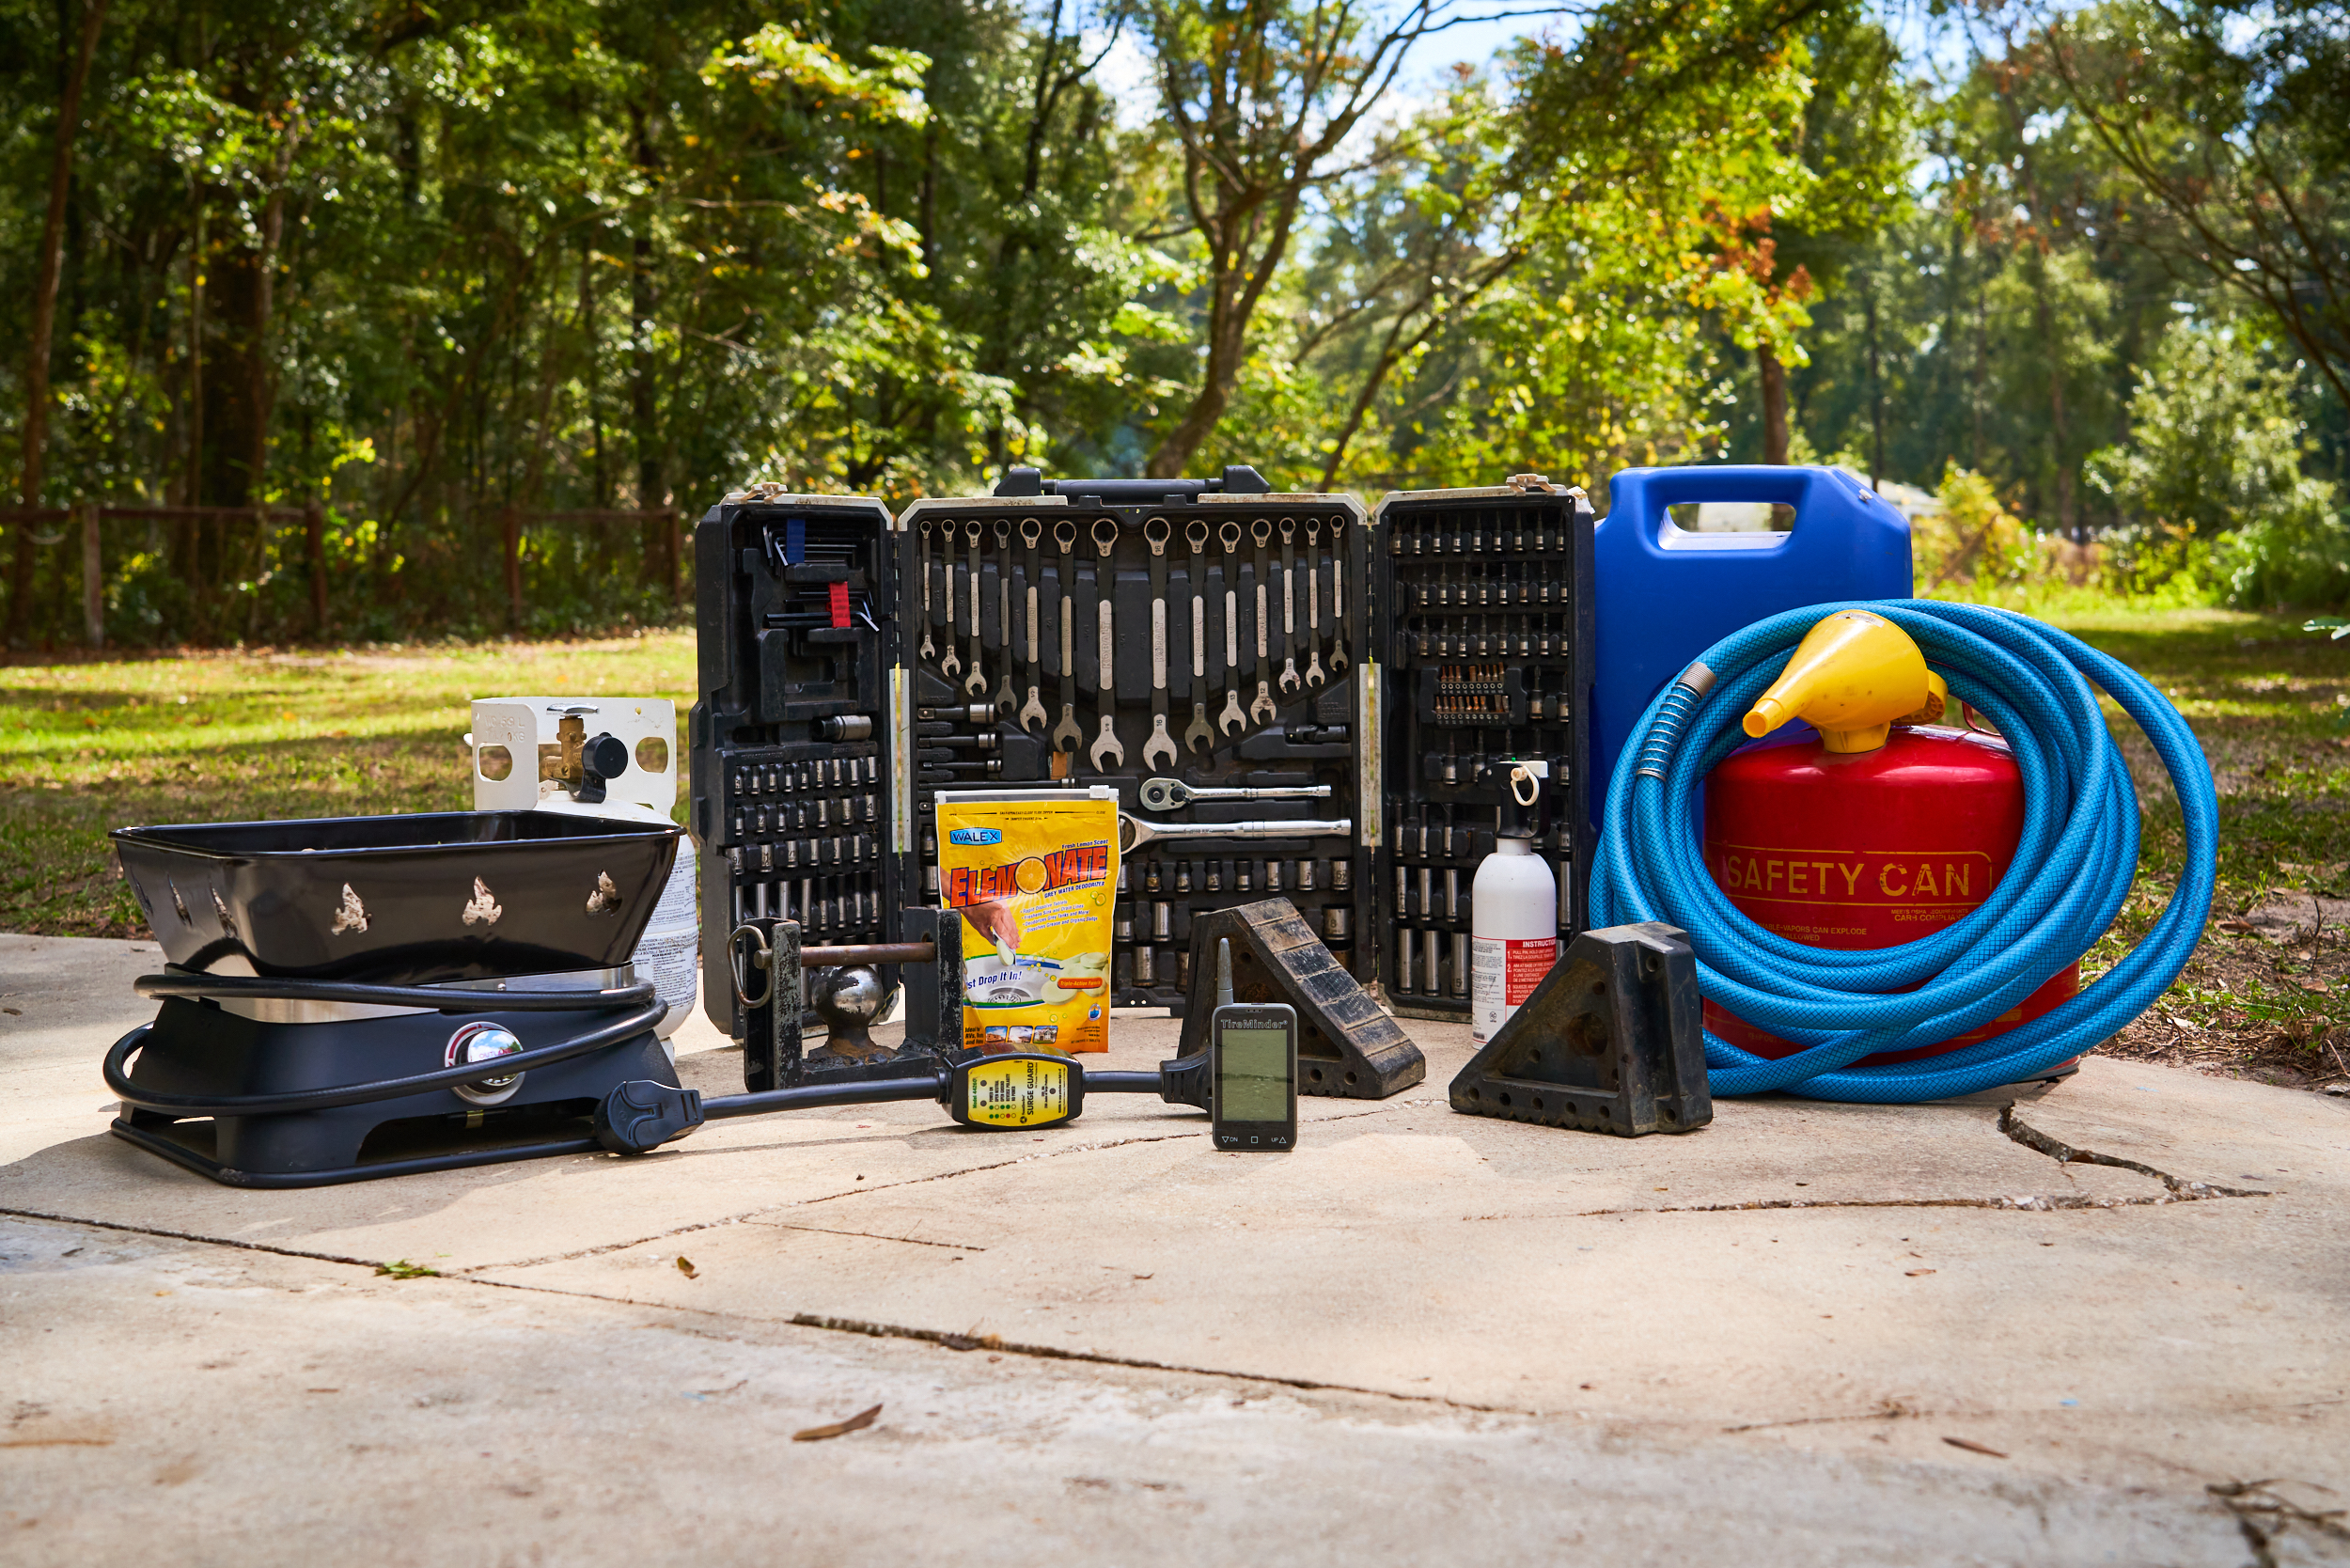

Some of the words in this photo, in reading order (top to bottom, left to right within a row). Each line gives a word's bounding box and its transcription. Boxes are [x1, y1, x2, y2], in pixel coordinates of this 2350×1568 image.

[1155, 545, 1162, 554] 16
[1194, 544, 1200, 553] 14
[1028, 607, 1037, 642] KOBALT
[1228, 610, 1236, 646] KOBALT
[1154, 621, 1165, 662] KOBALT
[1195, 616, 1203, 657] KOBALT
[1102, 621, 1112, 668] KOBALT
[1156, 719, 1163, 728] 16
[952, 832, 998, 842] WALEX
[1728, 855, 1865, 896] SAFETY
[1879, 863, 1970, 897] CAN
[1044, 890, 1057, 899] GREY
[1058, 886, 1074, 895] WATER
[1075, 881, 1105, 890] DEODORIZER
[1026, 917, 1047, 926] Deodorizes
[1894, 914, 1918, 922] CARB
[1758, 922, 1810, 933] MABLE-VAPORS
[1830, 927, 1868, 935] EXPLODE
[1507, 950, 1512, 959] 1.
[1507, 964, 1512, 973] 2.
[979, 974, 997, 986] Drop
[999, 971, 1007, 981] It
[1009, 970, 1023, 980] In!
[1507, 984, 1512, 994] 3.
